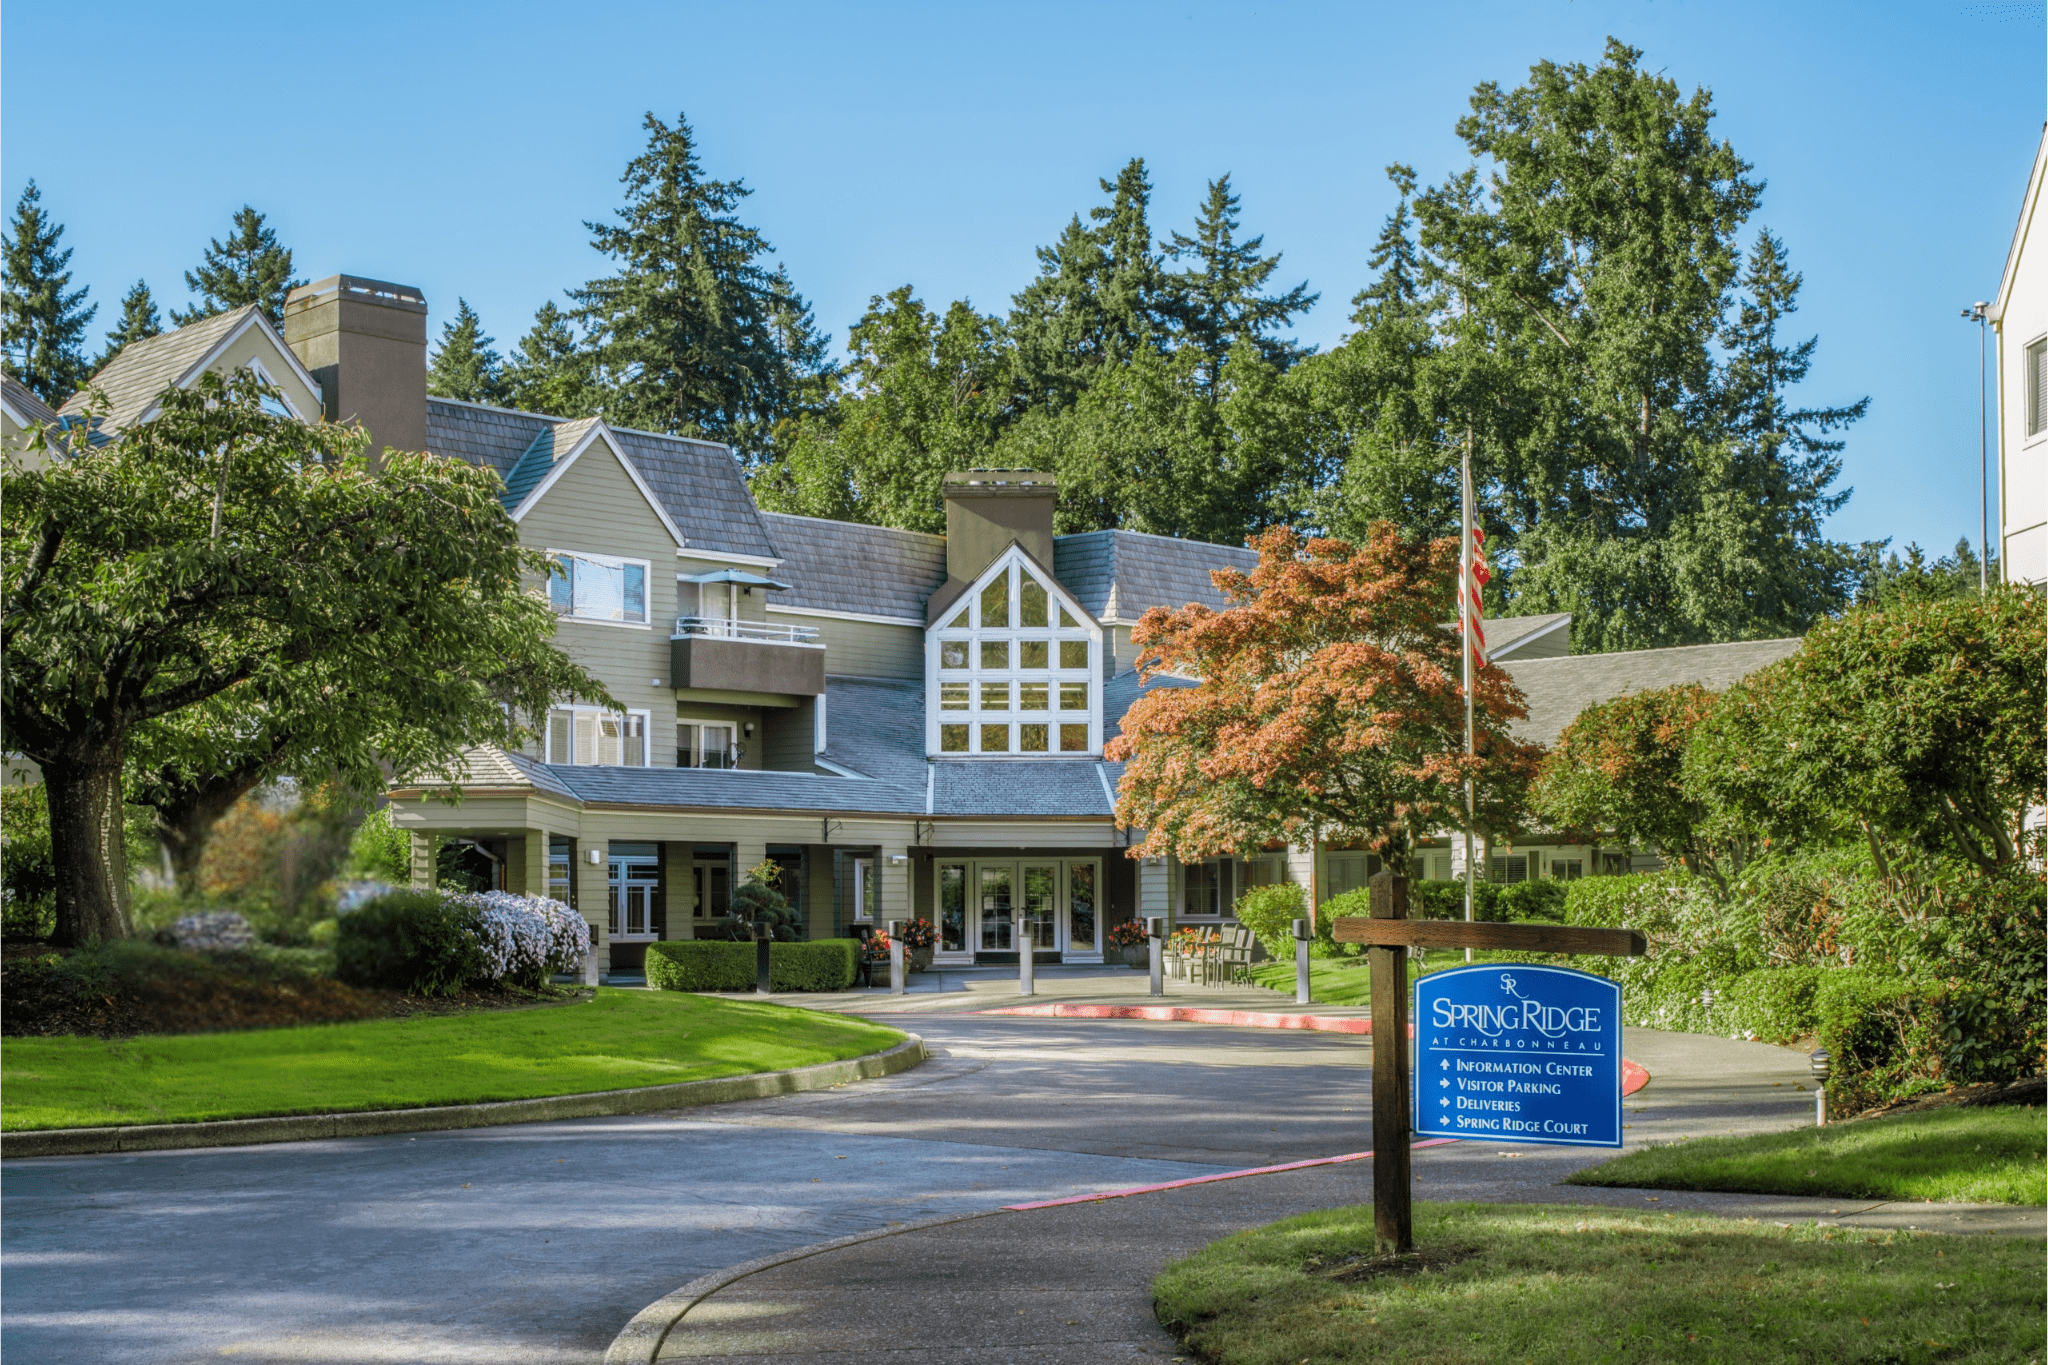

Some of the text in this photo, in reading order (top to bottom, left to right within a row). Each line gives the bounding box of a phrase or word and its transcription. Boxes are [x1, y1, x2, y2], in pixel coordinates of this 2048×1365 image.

[1432, 1037, 1601, 1051] AT CHARBONNEAU
[1456, 1058, 1593, 1077] INFORMATION CENTER
[1456, 1077, 1561, 1095] VISITOR PARKING
[1456, 1095, 1521, 1112] DELIVERIES
[1456, 1114, 1589, 1135] SPRING RIDGE COURT
